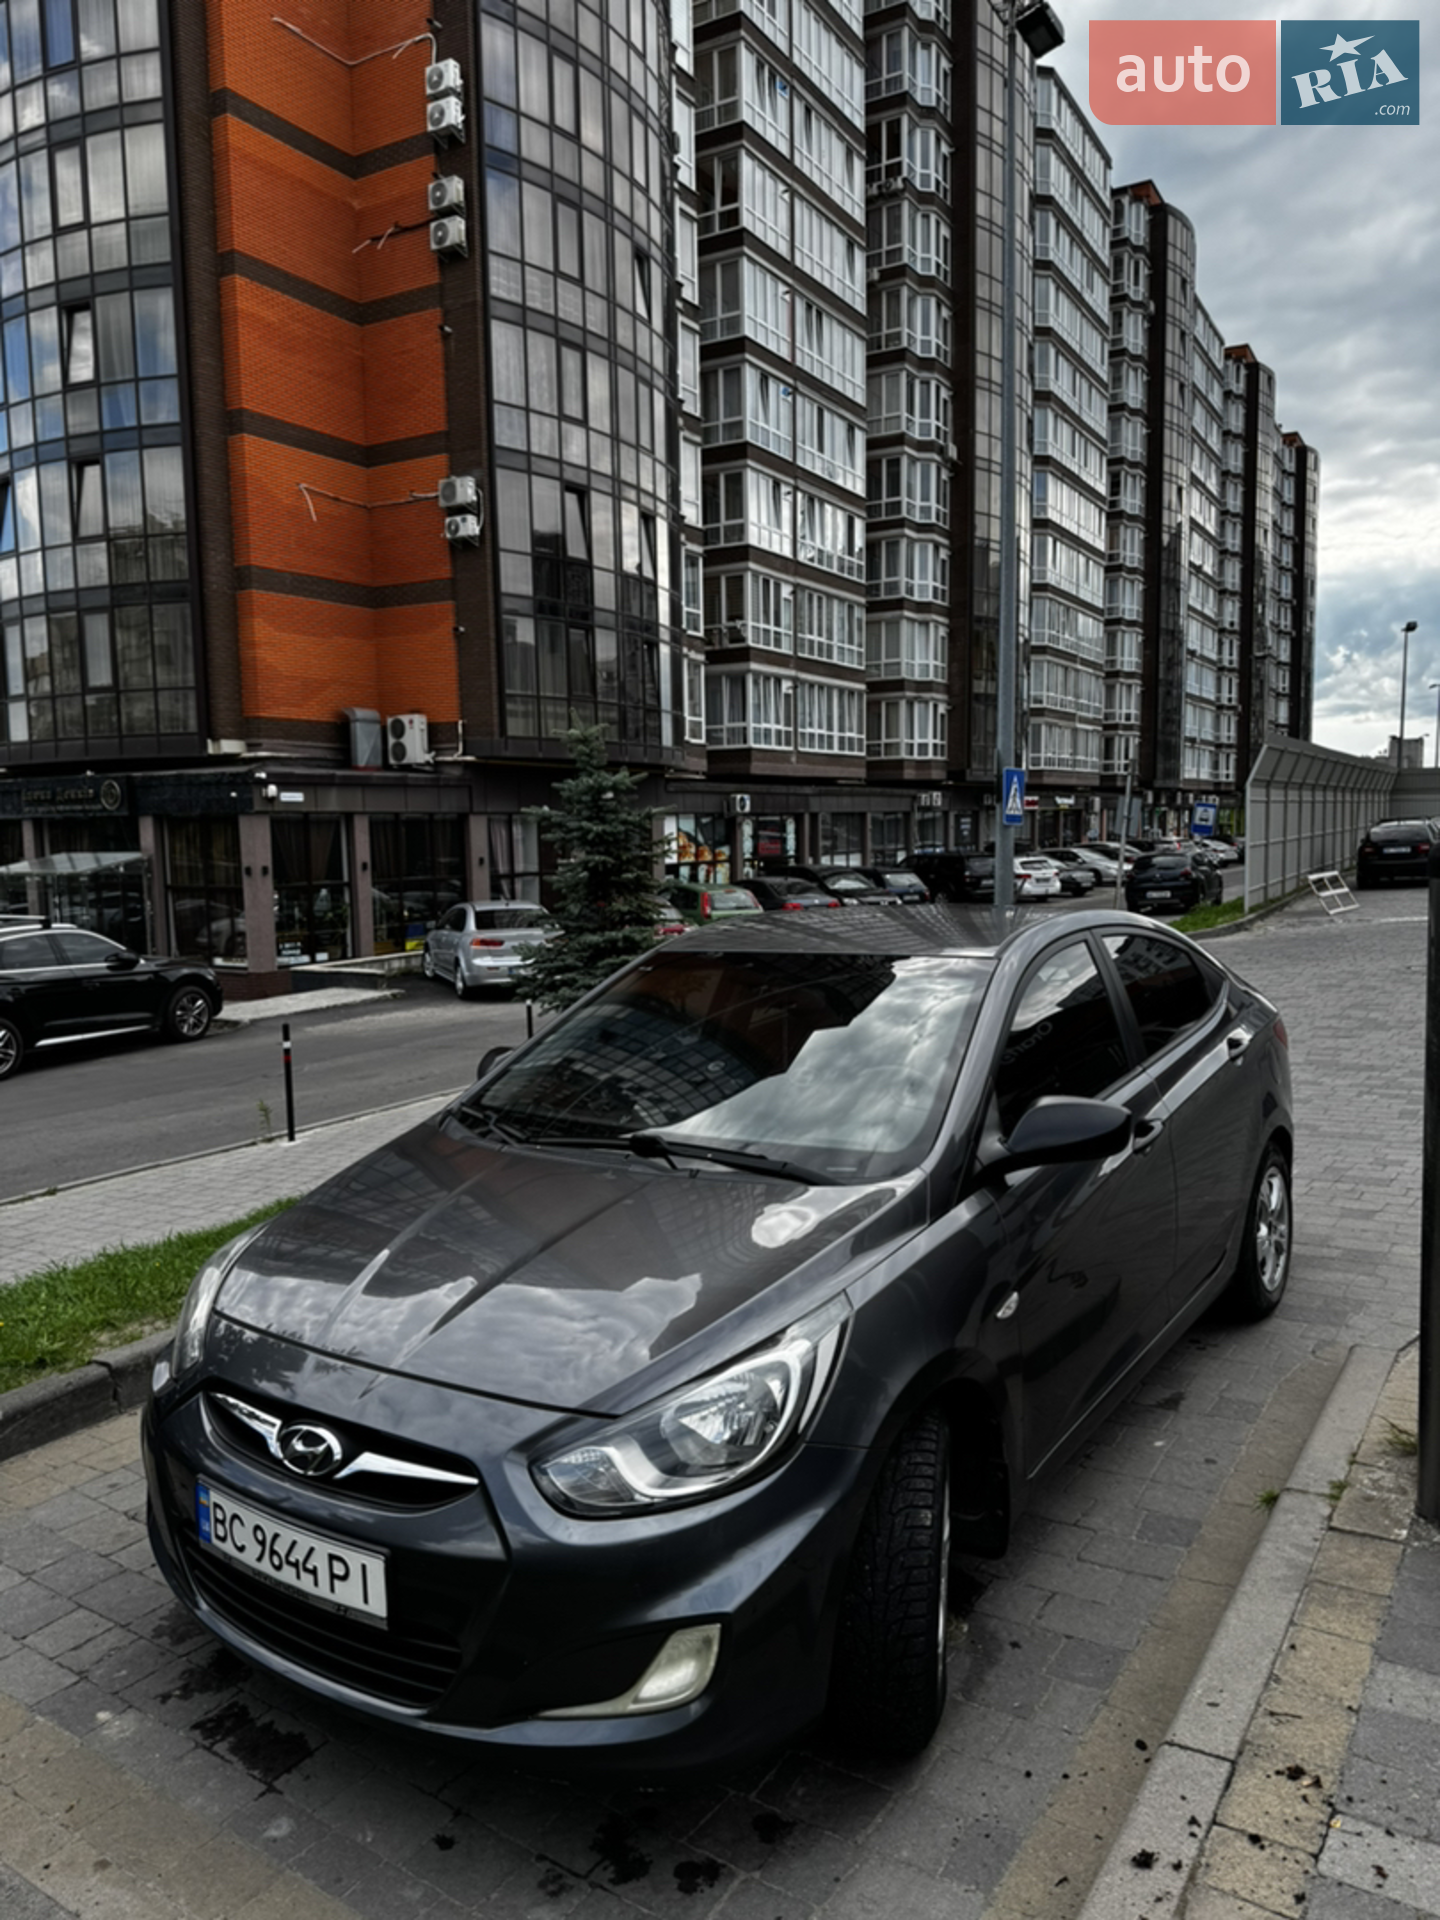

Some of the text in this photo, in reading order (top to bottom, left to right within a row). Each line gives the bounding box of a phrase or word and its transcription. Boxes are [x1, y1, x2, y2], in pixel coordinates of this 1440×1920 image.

[213, 1502, 246, 1553] BC
[252, 1524, 319, 1588] 9644
[327, 1553, 369, 1605] PI
